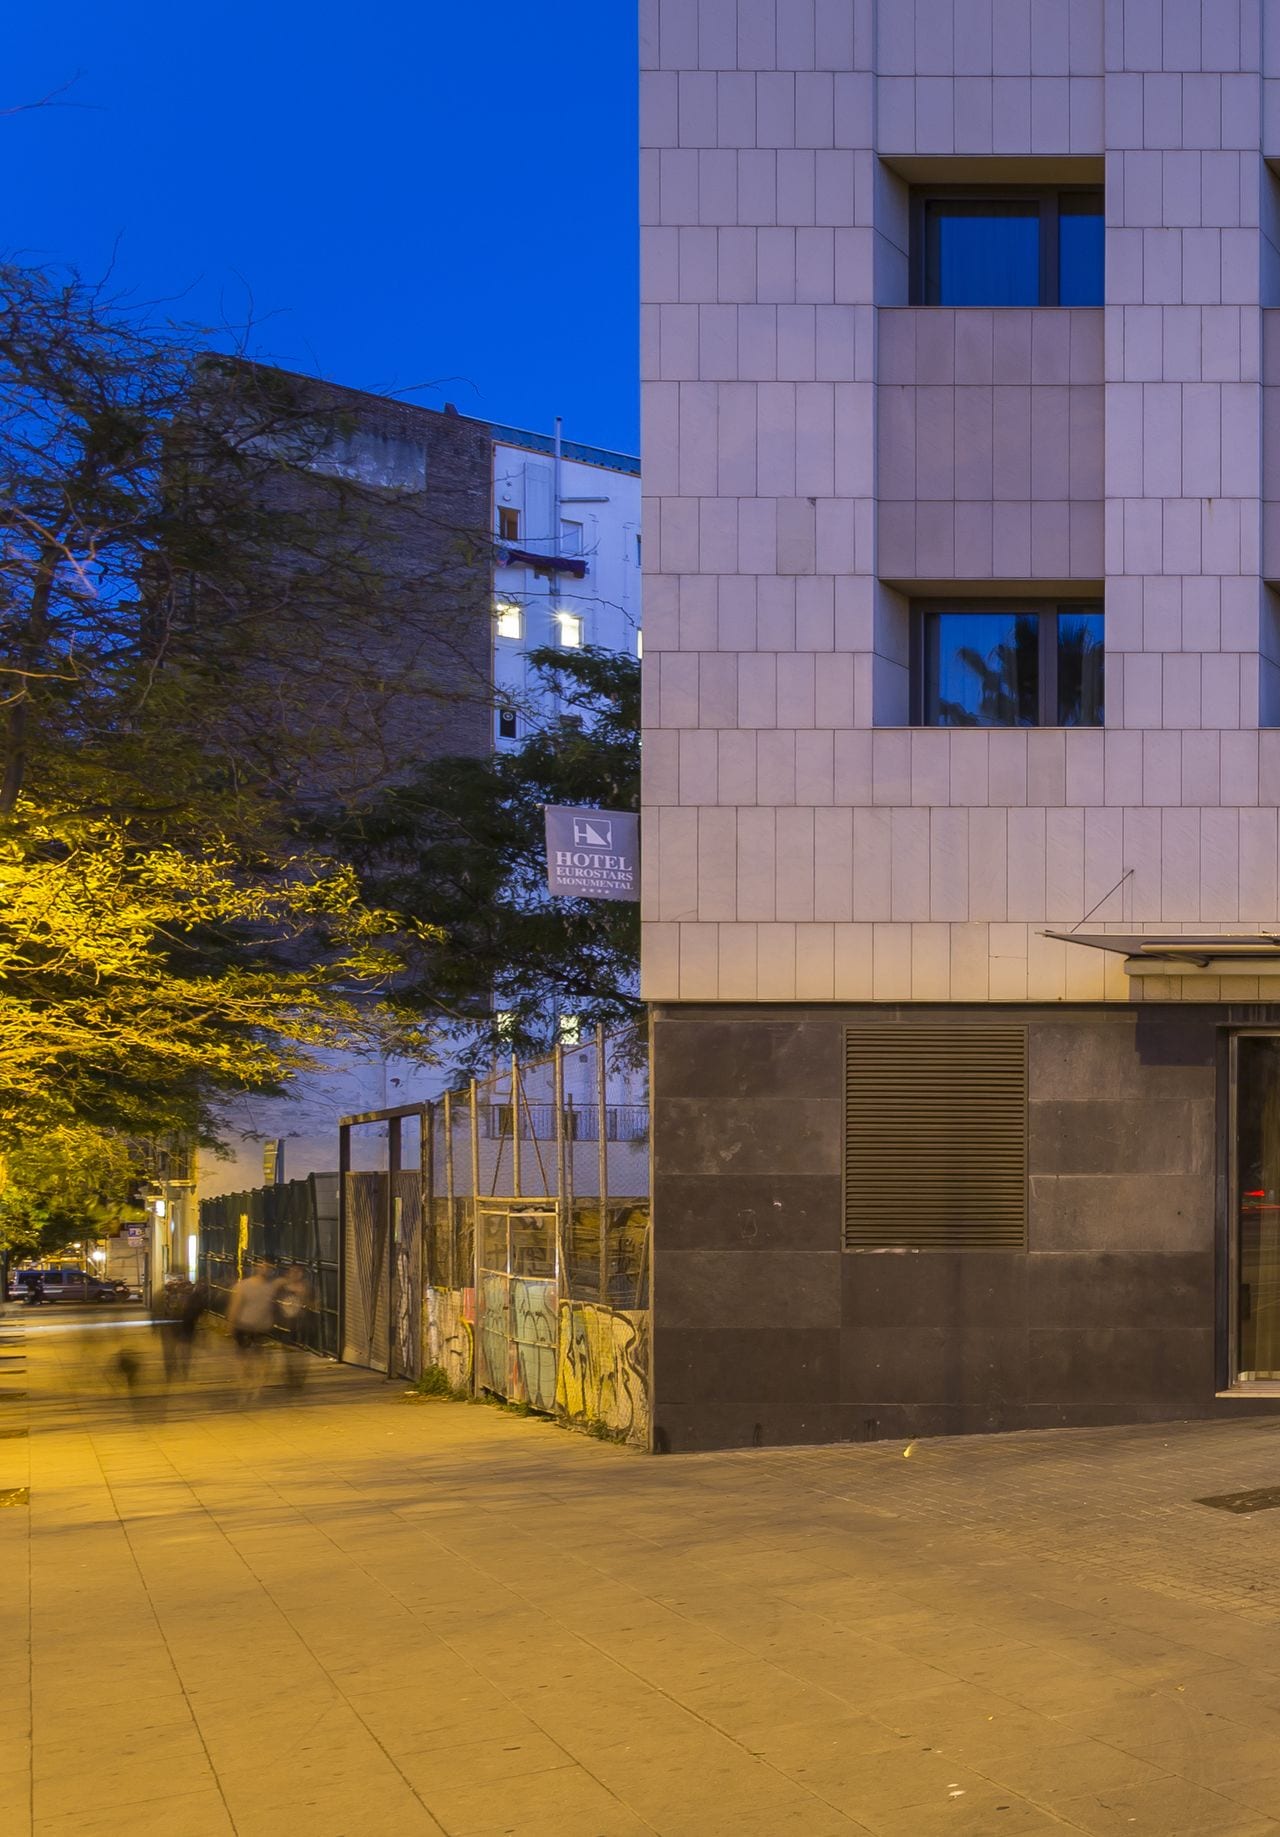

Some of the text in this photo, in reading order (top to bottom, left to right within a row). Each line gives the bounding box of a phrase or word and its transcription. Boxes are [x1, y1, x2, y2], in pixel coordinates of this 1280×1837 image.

[556, 851, 632, 871] HOTEL
[556, 867, 633, 881] EUROSTARS
[556, 877, 634, 890] MONUMENTAL
